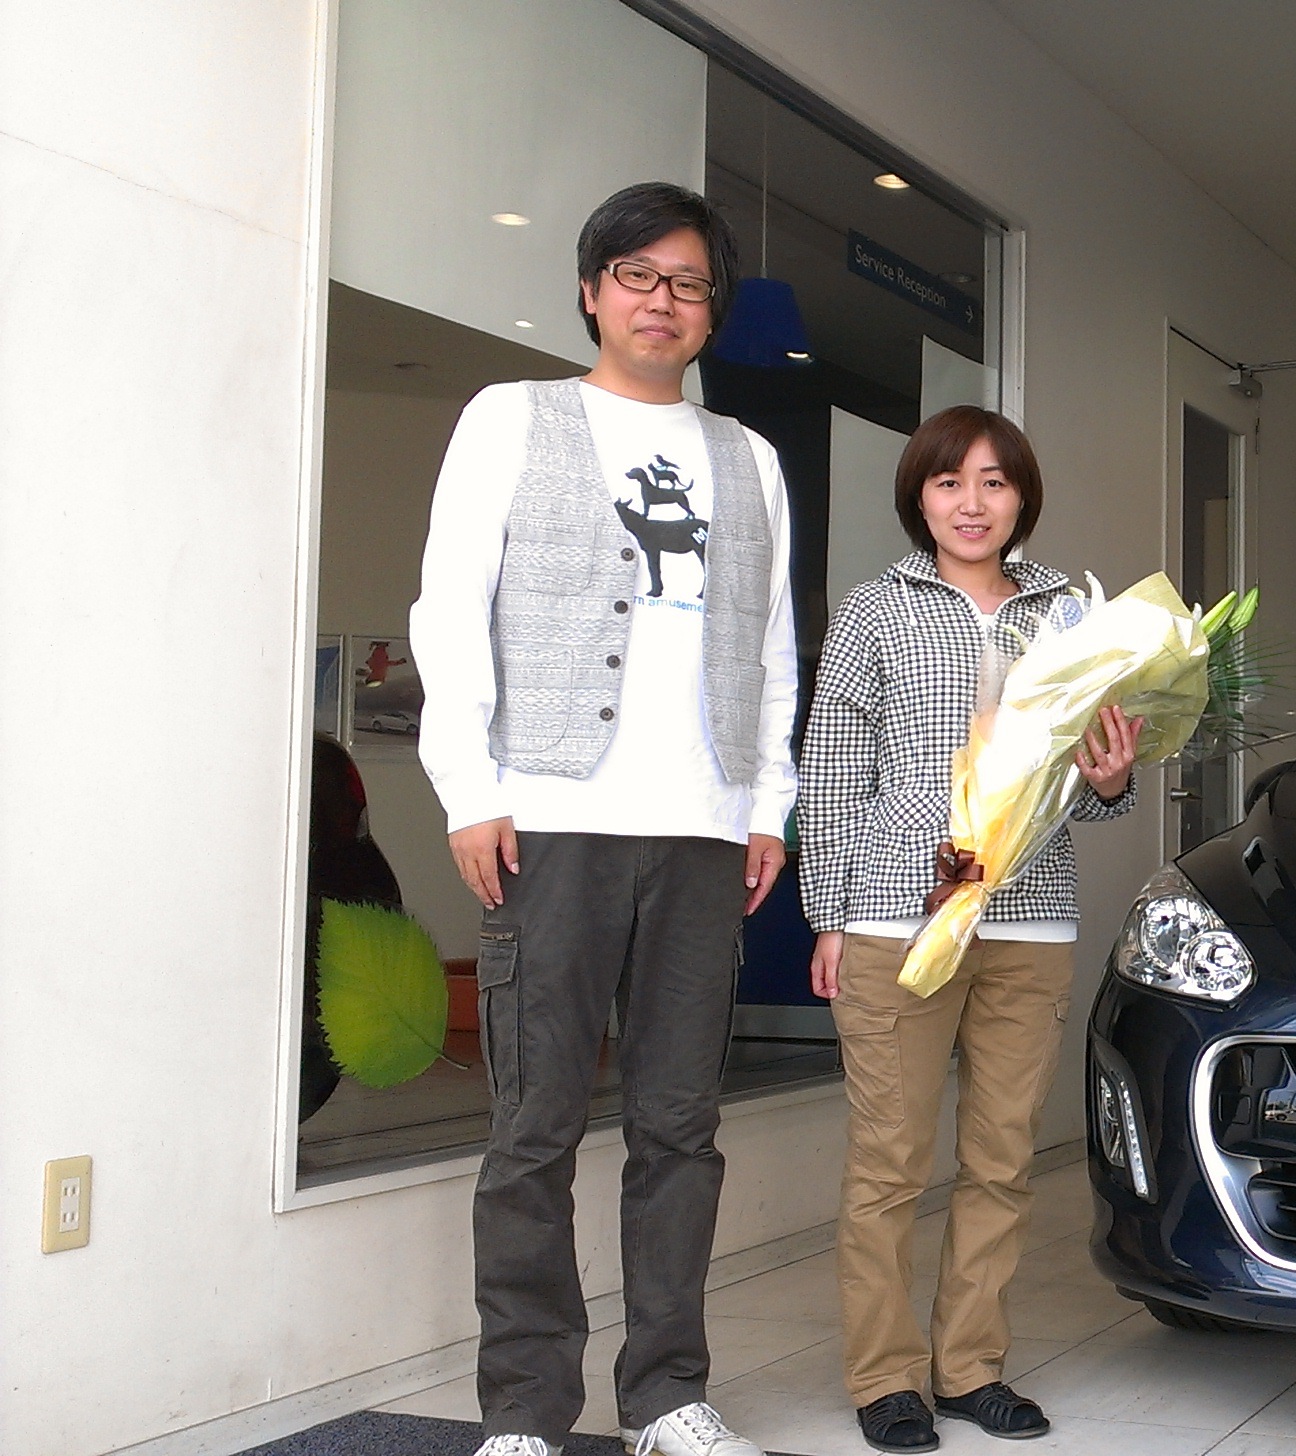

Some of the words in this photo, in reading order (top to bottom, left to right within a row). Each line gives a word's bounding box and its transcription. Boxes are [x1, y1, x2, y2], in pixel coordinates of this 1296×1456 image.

[855, 244, 895, 281] Service
[897, 267, 947, 308] Reception
[648, 598, 703, 613] amuseme
